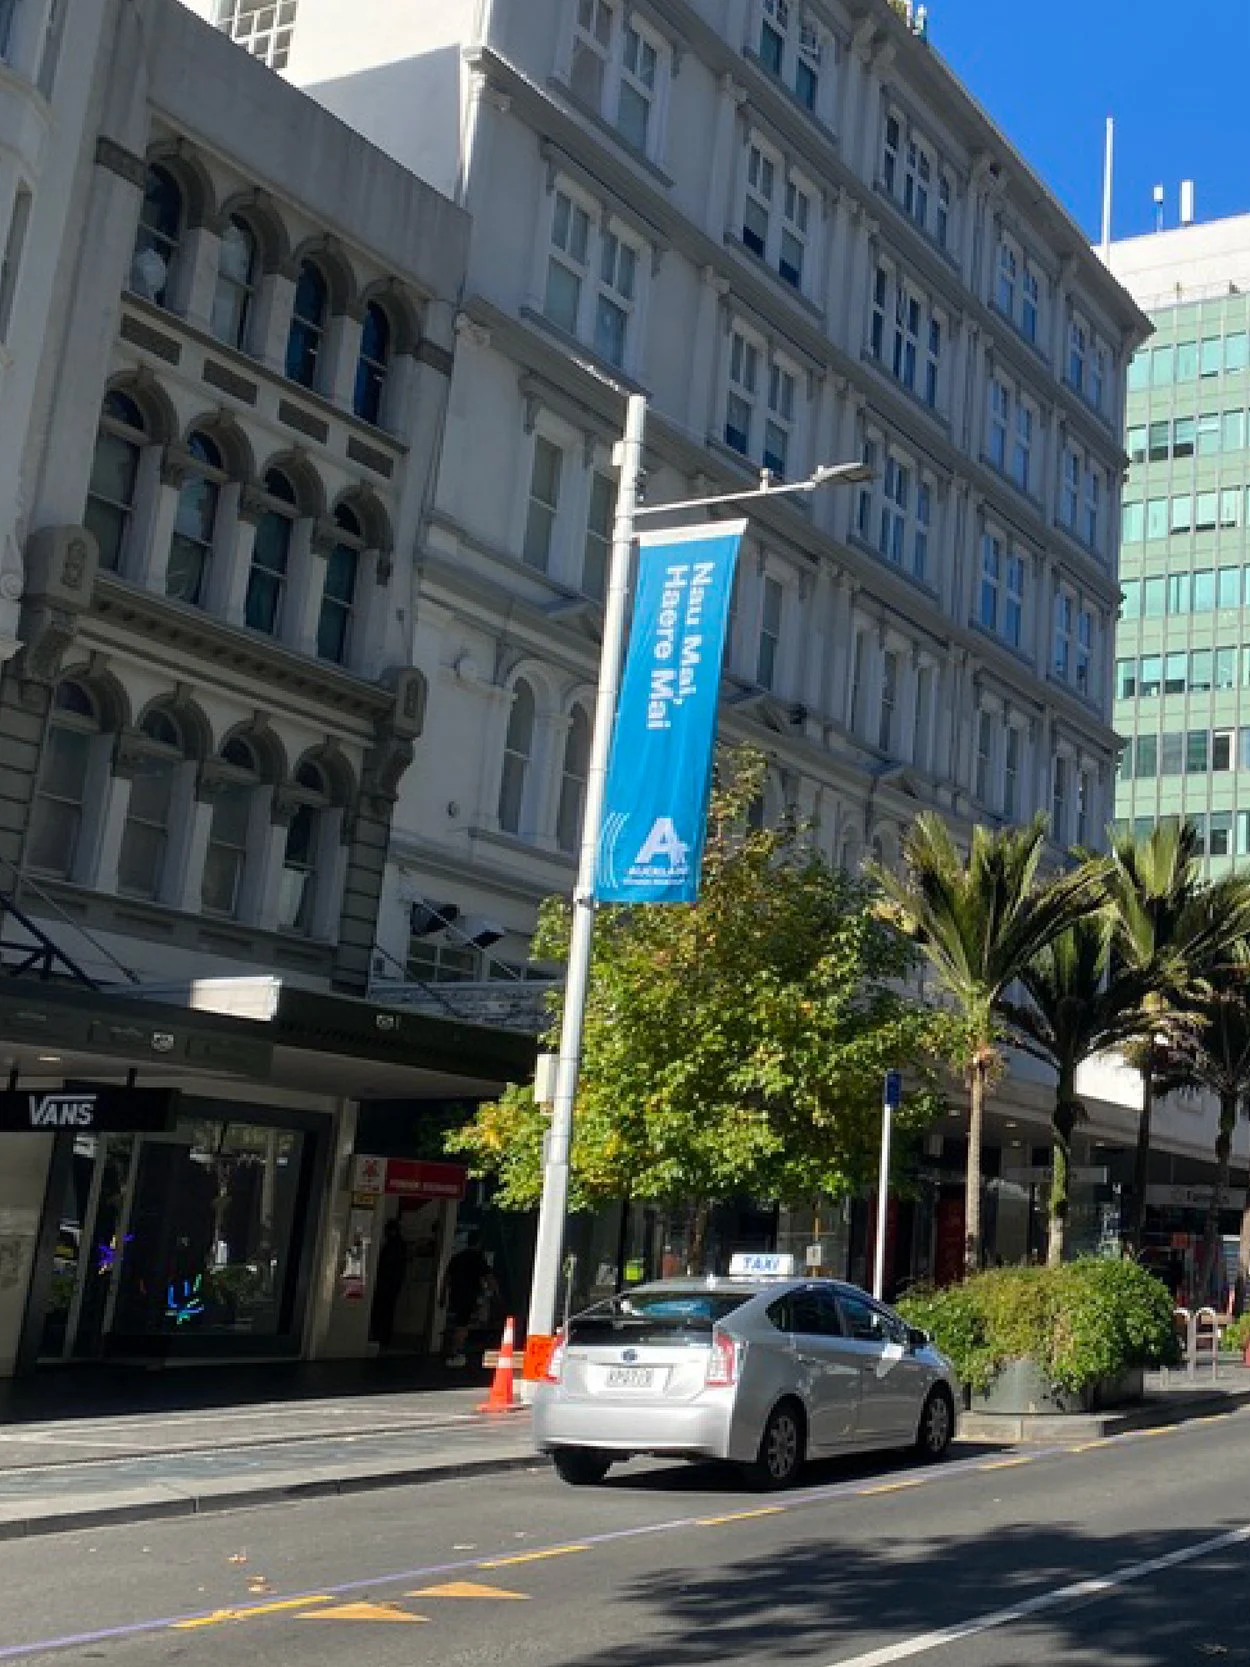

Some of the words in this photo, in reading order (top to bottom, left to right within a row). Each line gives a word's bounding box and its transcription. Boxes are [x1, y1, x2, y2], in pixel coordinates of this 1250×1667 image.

[653, 564, 690, 660] Haere
[686, 562, 716, 625] Nau
[646, 668, 678, 730] Mai
[28, 1094, 97, 1125] VANS
[743, 1256, 780, 1271] TAXI
